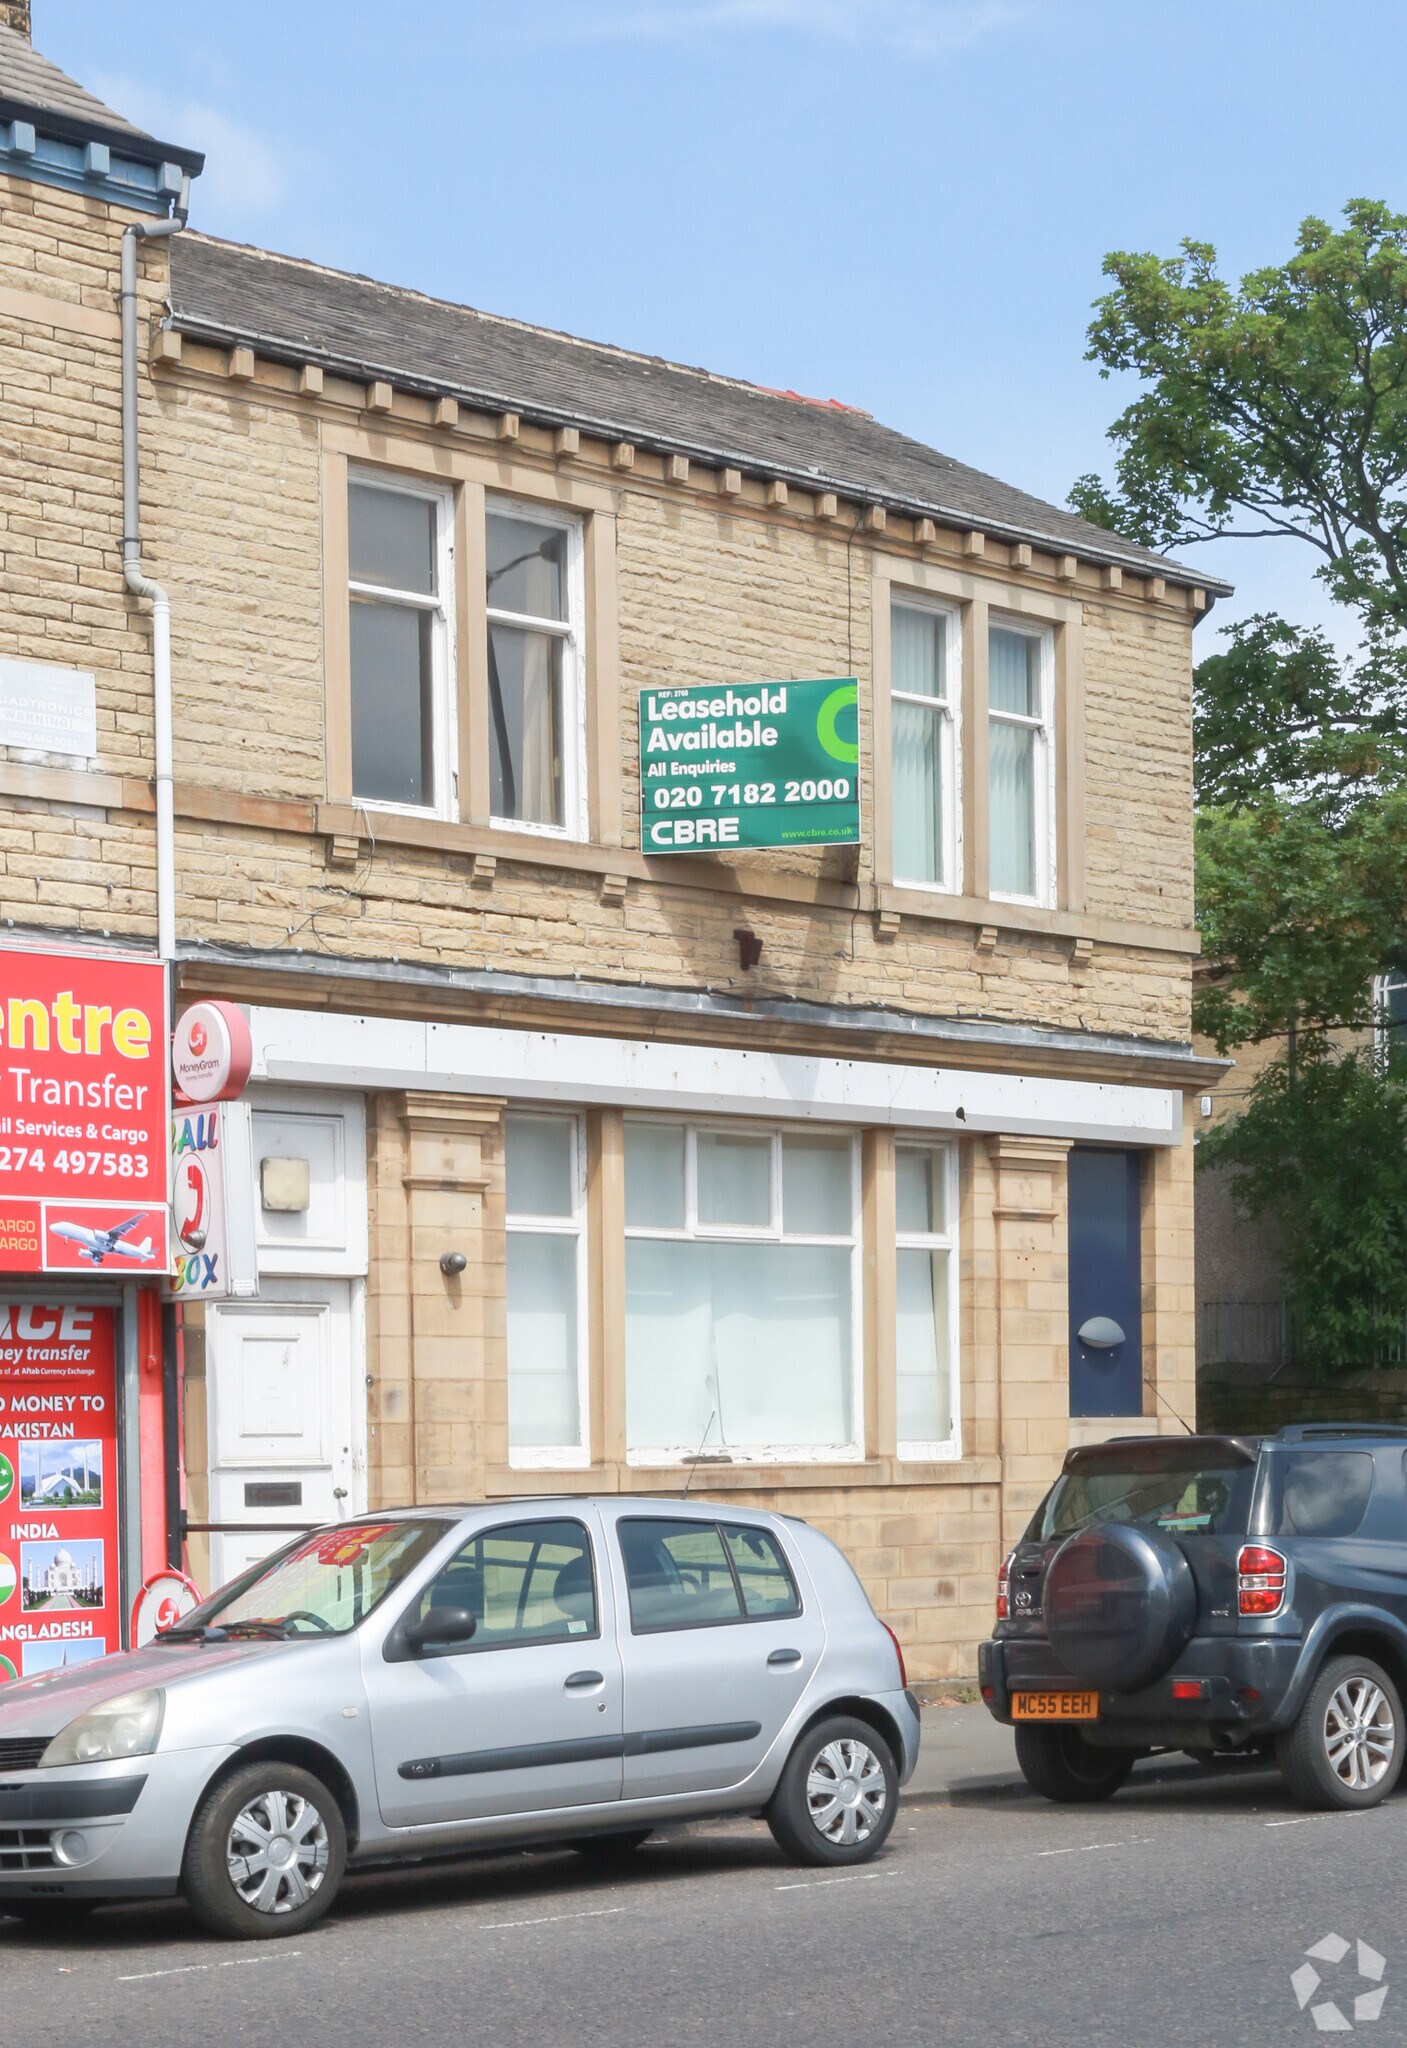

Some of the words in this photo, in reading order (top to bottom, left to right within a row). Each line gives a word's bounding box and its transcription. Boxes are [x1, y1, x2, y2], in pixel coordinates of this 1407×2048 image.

[648, 687, 787, 721] Leasehold
[647, 720, 778, 753] Available
[647, 762, 667, 777] All
[670, 759, 736, 778] Enquiries
[654, 786, 702, 809] 020
[710, 783, 776, 805] 7182
[784, 778, 850, 802] 2000
[650, 817, 739, 845] CBRE
[781, 826, 853, 839] www.cbre.co.uk
[0, 990, 152, 1060] ntre
[179, 1059, 219, 1074] MoneyGram
[8, 1067, 148, 1111] Transfer
[0, 1117, 12, 1134] il
[15, 1119, 83, 1139] Services
[85, 1123, 98, 1139] &
[101, 1125, 149, 1145] Cargo
[53, 1150, 149, 1178] 497583
[0, 1348, 23, 1365] ey
[26, 1344, 91, 1361] transfer
[21, 1367, 40, 1375] Aftab
[40, 1367, 67, 1376] Currency
[67, 1368, 96, 1376] Exchange
[10, 1395, 77, 1412] MONEY
[80, 1395, 105, 1412] TO
[0, 1422, 75, 1438] AKISTAN
[10, 1522, 59, 1540] INDIA
[0, 1620, 93, 1641] NGLADESH
[1017, 1695, 1057, 1714] MC55
[1060, 1694, 1091, 1714] EEH
[411, 1763, 435, 1773] 16V
